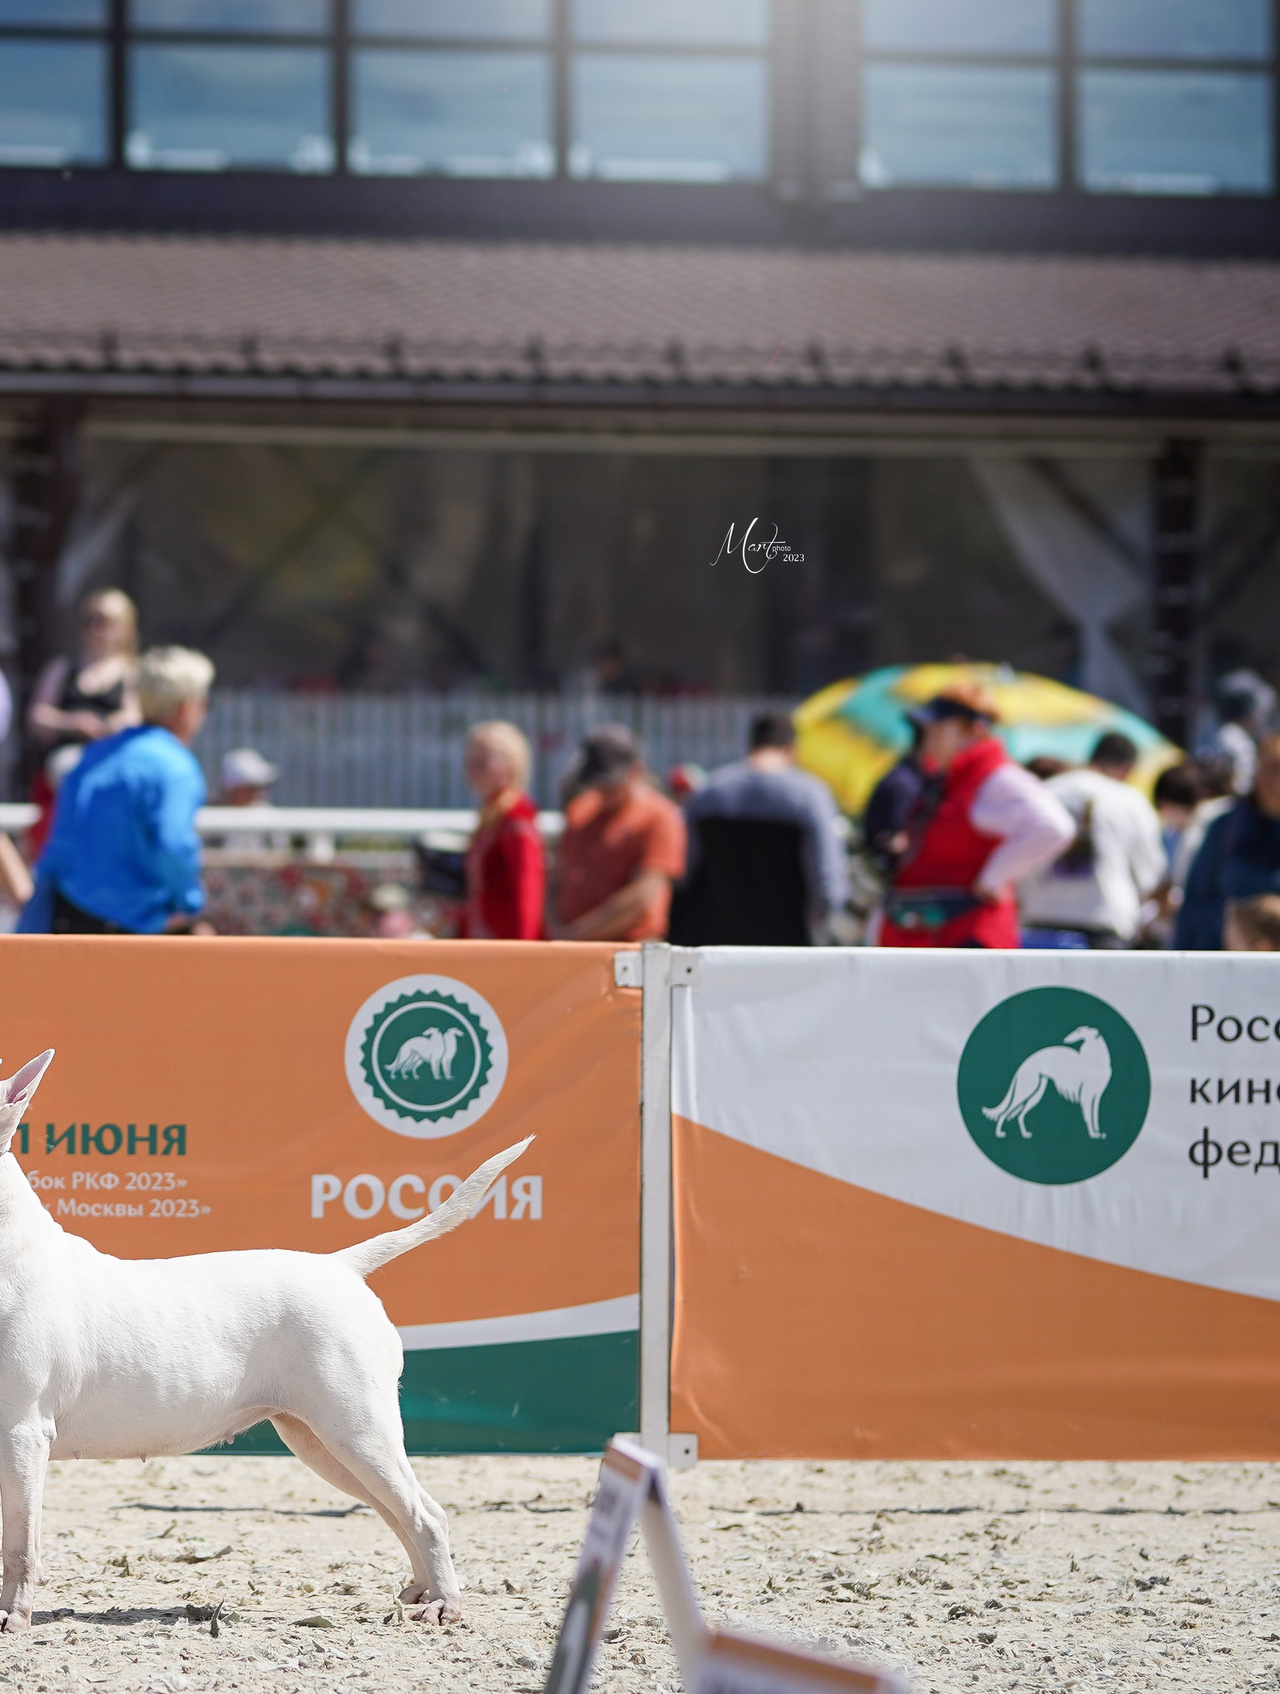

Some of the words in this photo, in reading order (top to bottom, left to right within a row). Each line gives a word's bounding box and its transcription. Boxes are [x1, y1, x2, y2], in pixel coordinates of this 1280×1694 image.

[1190, 1076, 1280, 1104] кин
[45, 1122, 187, 1156] ИЮНЯ
[72, 1171, 120, 1190] РКФ
[125, 1171, 188, 1191] 2023»
[56, 1198, 143, 1218] Москвы
[149, 1199, 212, 1218] 2023»
